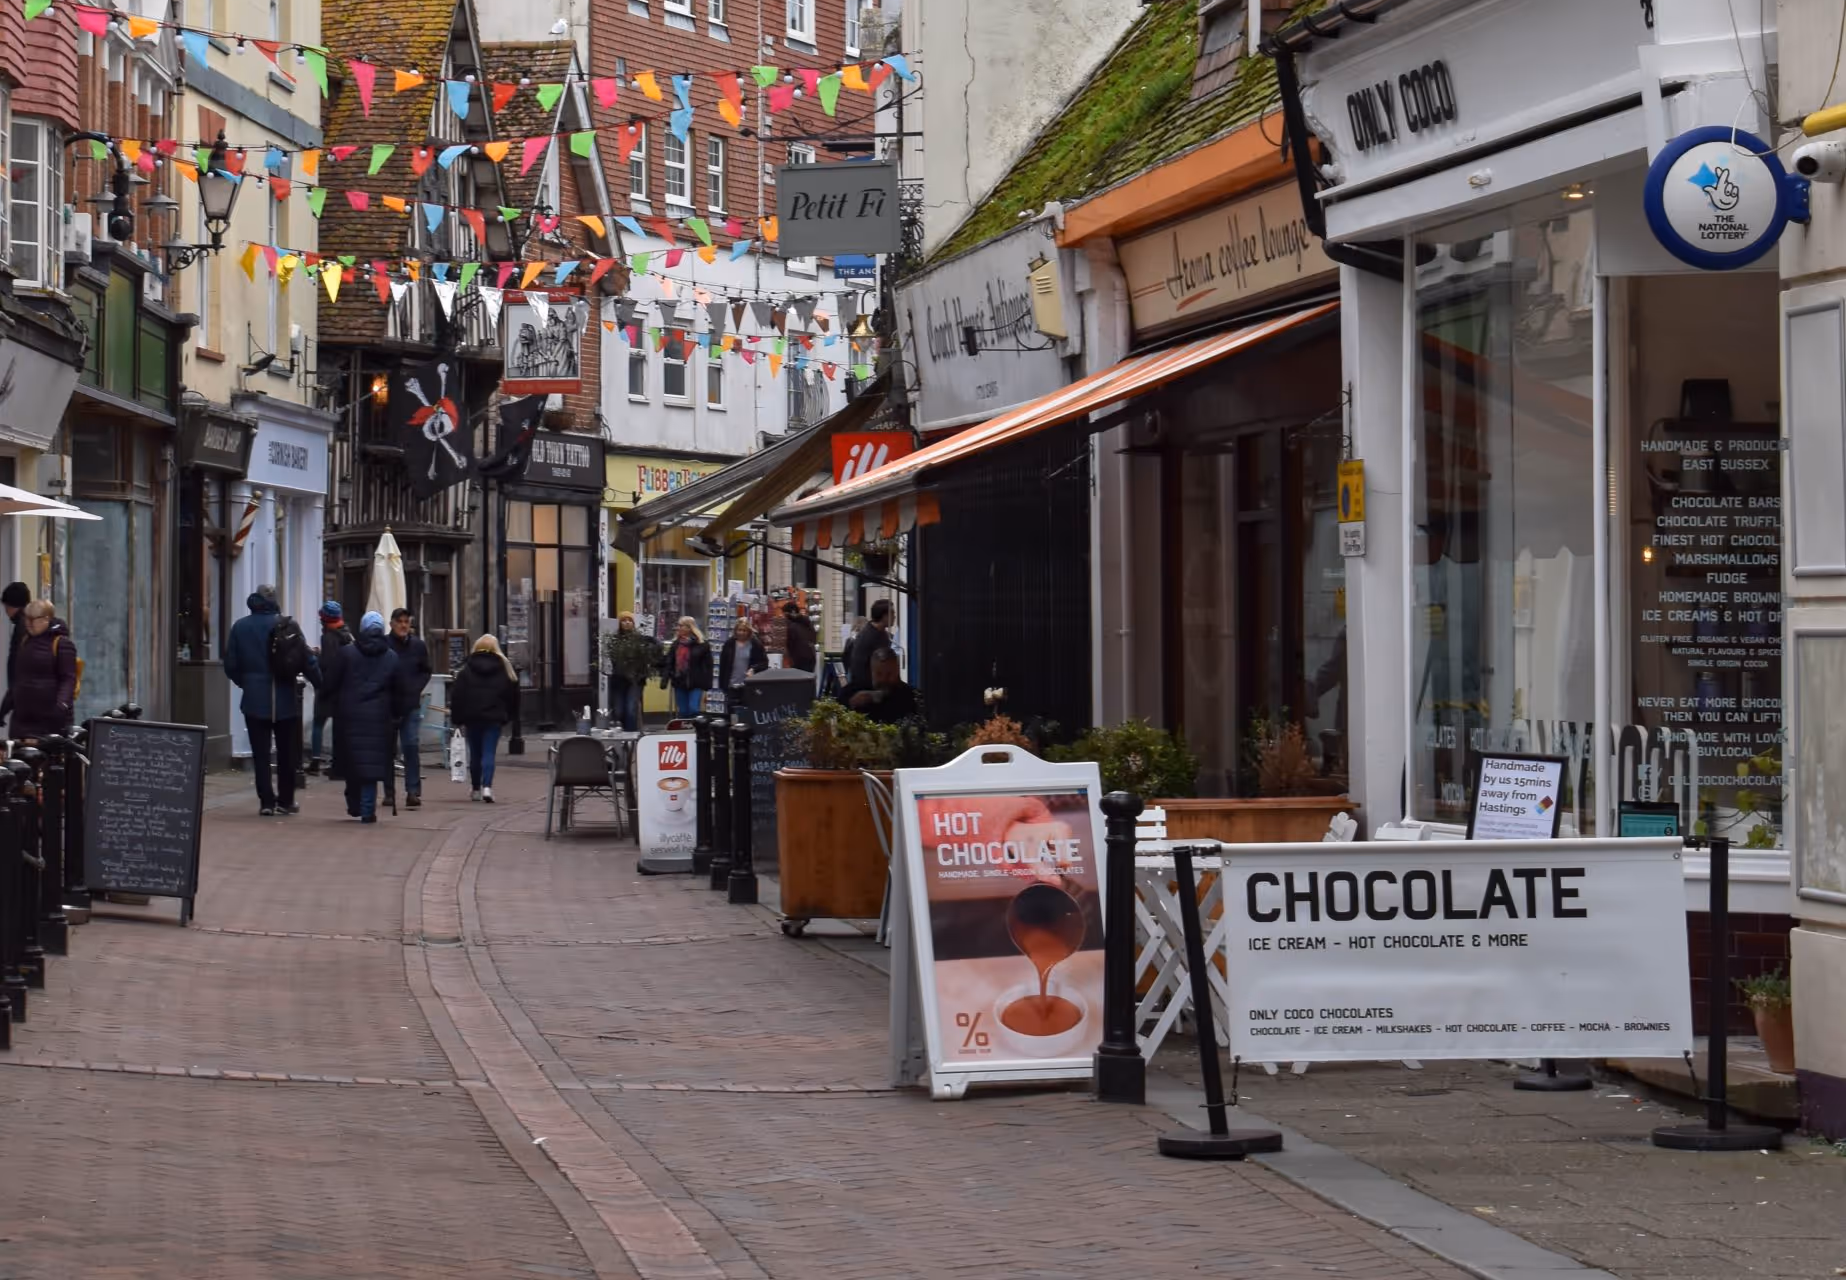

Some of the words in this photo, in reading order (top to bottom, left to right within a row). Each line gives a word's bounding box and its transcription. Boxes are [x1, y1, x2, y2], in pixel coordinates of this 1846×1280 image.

[1346, 80, 1397, 151] ONLY
[1399, 59, 1457, 133] COCO
[787, 191, 848, 221] Petit
[856, 188, 887, 218] Fi
[1699, 223, 1749, 231] NATIONAL
[1701, 232, 1746, 240] LOTTERY
[1166, 231, 1215, 300] Aroma
[1218, 213, 1259, 290] coffee
[1259, 205, 1310, 273] lounge
[838, 268, 856, 276] THE
[1641, 440, 1709, 452] HANDMADE
[841, 442, 893, 484] ill
[1682, 459, 1714, 471] EAST
[1721, 459, 1769, 471] SUSSEX
[1672, 496, 1742, 508] CHOCOLATE
[1748, 497, 1783, 508] BARS
[1657, 516, 1728, 527] CHOCOLATE
[1734, 516, 1783, 527] TRUFFL
[1652, 534, 1695, 546] FINEST
[1701, 535, 1725, 546] HOT
[1676, 554, 1778, 565] MARSHMALLOWS
[1707, 573, 1748, 584] FUDGE
[1659, 591, 1728, 603] HOMEMADE
[1642, 610, 1662, 621] ICE
[1668, 610, 1718, 622] CREAMS
[1739, 610, 1761, 622] HOT
[1640, 635, 1669, 643] GLUTEN
[1740, 636, 1765, 644] VEGAN
[1708, 648, 1746, 656] FLAVOURS
[1688, 659, 1713, 667] SINGLE
[1743, 660, 1769, 668] COCOA
[1638, 697, 1675, 707] NEVER
[1680, 698, 1700, 707] EAT
[1706, 698, 1736, 707] MORE
[1664, 712, 1692, 722] THEN
[1698, 712, 1720, 722] YOU
[1726, 713, 1748, 722] CAN
[1657, 732, 1719, 743] HNDADE
[1724, 733, 1751, 743] WITH
[660, 745, 686, 768] illy
[1485, 759, 1545, 773] Handmade
[1483, 773, 1497, 785] by
[1499, 777, 1511, 785] us
[1514, 777, 1552, 788] 15mins
[1481, 791, 1508, 801] away
[1512, 790, 1537, 801] from
[1479, 801, 1527, 817] Hastings
[933, 811, 982, 837] HOT
[937, 838, 1083, 866] CHOCOLATE
[1246, 867, 1588, 923] CHOCOLATE
[1248, 938, 1271, 951] ICE
[1278, 936, 1326, 950] CREAM
[1349, 935, 1376, 949] HOT
[1383, 934, 1465, 949] CHOCOLATE
[1472, 934, 1481, 947] &
[1488, 933, 1529, 947] MORE
[1249, 1009, 1278, 1020] ONLY
[1284, 1008, 1314, 1020] COCO
[1320, 1007, 1394, 1019] CHOCOLATES
[1250, 1026, 1301, 1036] CHOCOLATE
[1314, 1026, 1328, 1035] ICE
[1332, 1025, 1363, 1035] CREAM
[1376, 1024, 1432, 1034] MILKSHAKES
[1445, 1024, 1463, 1033] HOT
[1467, 1023, 1518, 1033] CHOCOLATE
[1531, 1023, 1565, 1032] COFFEE
[1579, 1023, 1611, 1031] MOCHA
[1624, 1022, 1671, 1031] BROWNIES
